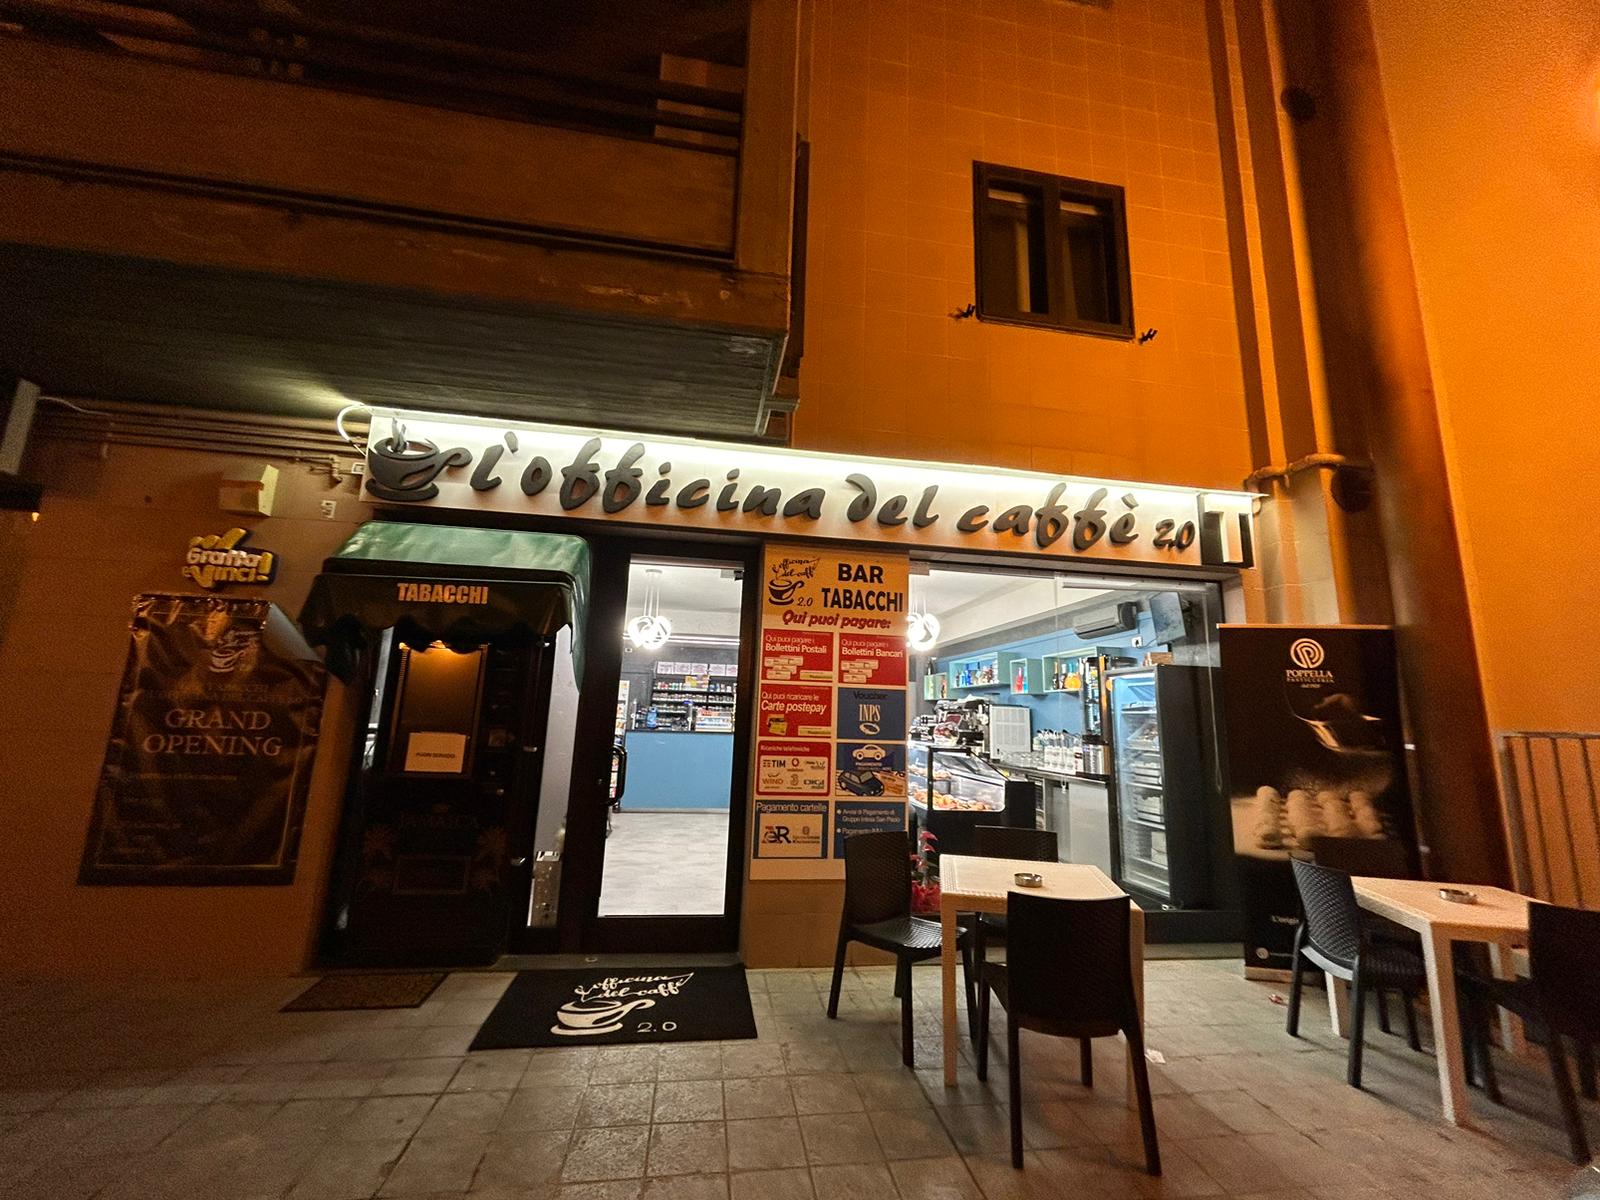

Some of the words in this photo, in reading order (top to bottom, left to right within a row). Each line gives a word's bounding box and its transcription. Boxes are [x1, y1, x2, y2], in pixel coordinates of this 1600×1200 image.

[844, 473, 940, 528] del
[956, 482, 1140, 550] caffè
[1152, 518, 1196, 550] 2.0
[837, 562, 884, 584] BAR
[397, 582, 489, 605] TABACCHI
[797, 597, 814, 607] 2.0
[821, 587, 904, 613] TABACCHI
[782, 610, 808, 625] Qui
[808, 613, 840, 628] puoi
[840, 618, 892, 630] pagare:
[765, 643, 801, 653] Bollettini
[801, 644, 828, 654] Postali
[841, 647, 875, 657] Bollettini
[1285, 669, 1334, 678] POPPELLA
[761, 699, 786, 711] Carte
[785, 702, 828, 716] postepay
[858, 703, 881, 722] INPS
[164, 706, 272, 730] GRAND
[143, 733, 283, 757] OPENING
[771, 759, 786, 768] TIM
[756, 801, 799, 813] Pagamento
[636, 1020, 678, 1033] 2.0
